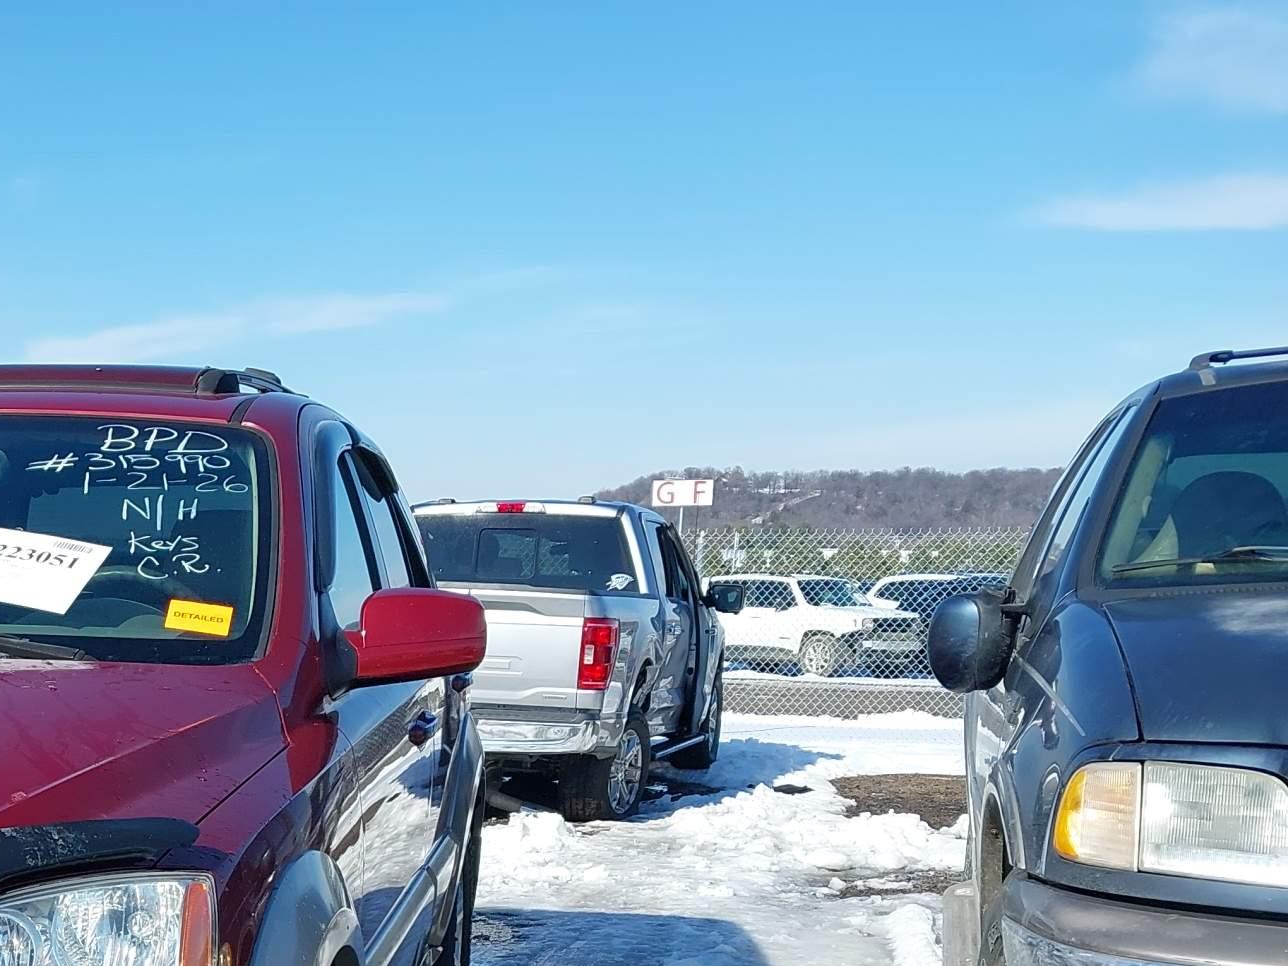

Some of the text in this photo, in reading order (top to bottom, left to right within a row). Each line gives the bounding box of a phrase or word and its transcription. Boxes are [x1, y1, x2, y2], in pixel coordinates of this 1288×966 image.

[96, 424, 228, 453] BPD
[83, 471, 249, 494] 1-21-26
[657, 480, 707, 504] G F
[173, 611, 224, 623] DETAILED
